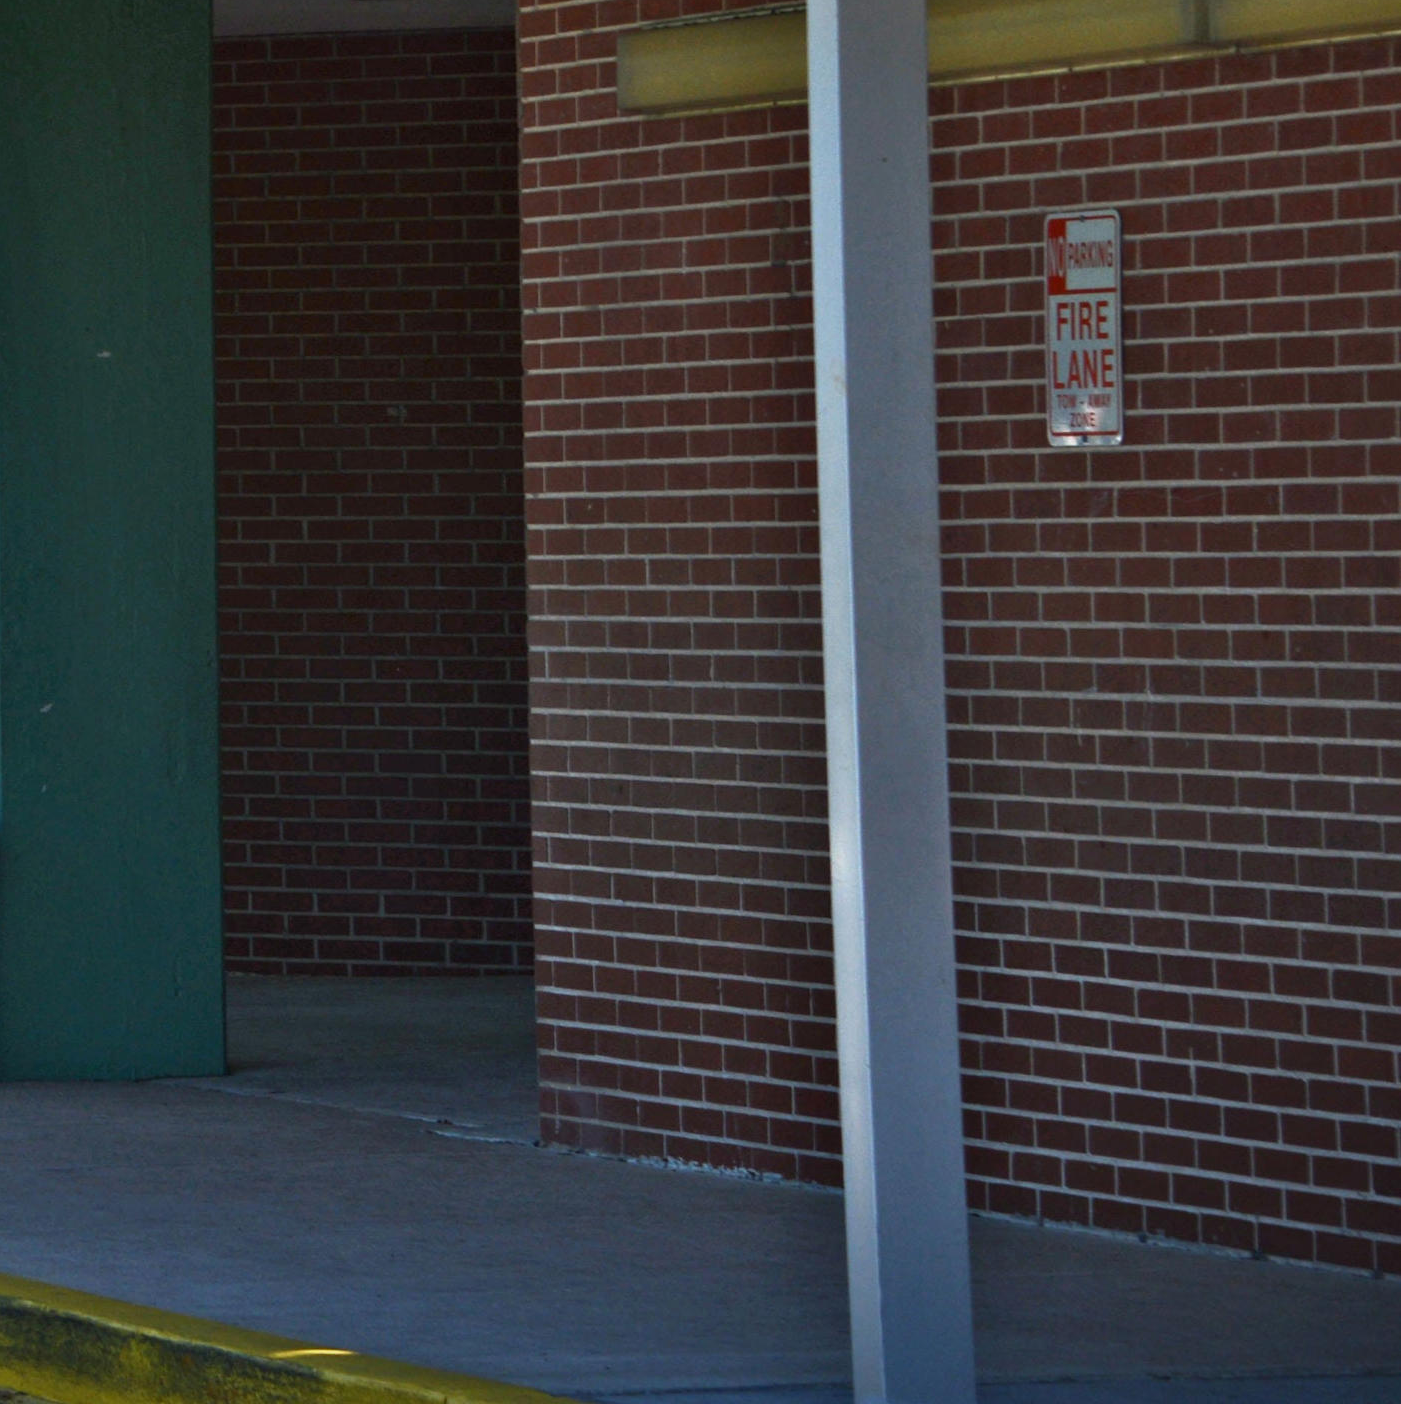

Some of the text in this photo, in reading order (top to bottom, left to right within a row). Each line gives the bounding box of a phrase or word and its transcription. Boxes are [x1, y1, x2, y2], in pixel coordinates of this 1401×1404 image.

[1067, 239, 1114, 269] PARKING
[1056, 300, 1109, 341] FIRE
[1052, 349, 1115, 389] LANE
[1070, 412, 1096, 428] ZONE
